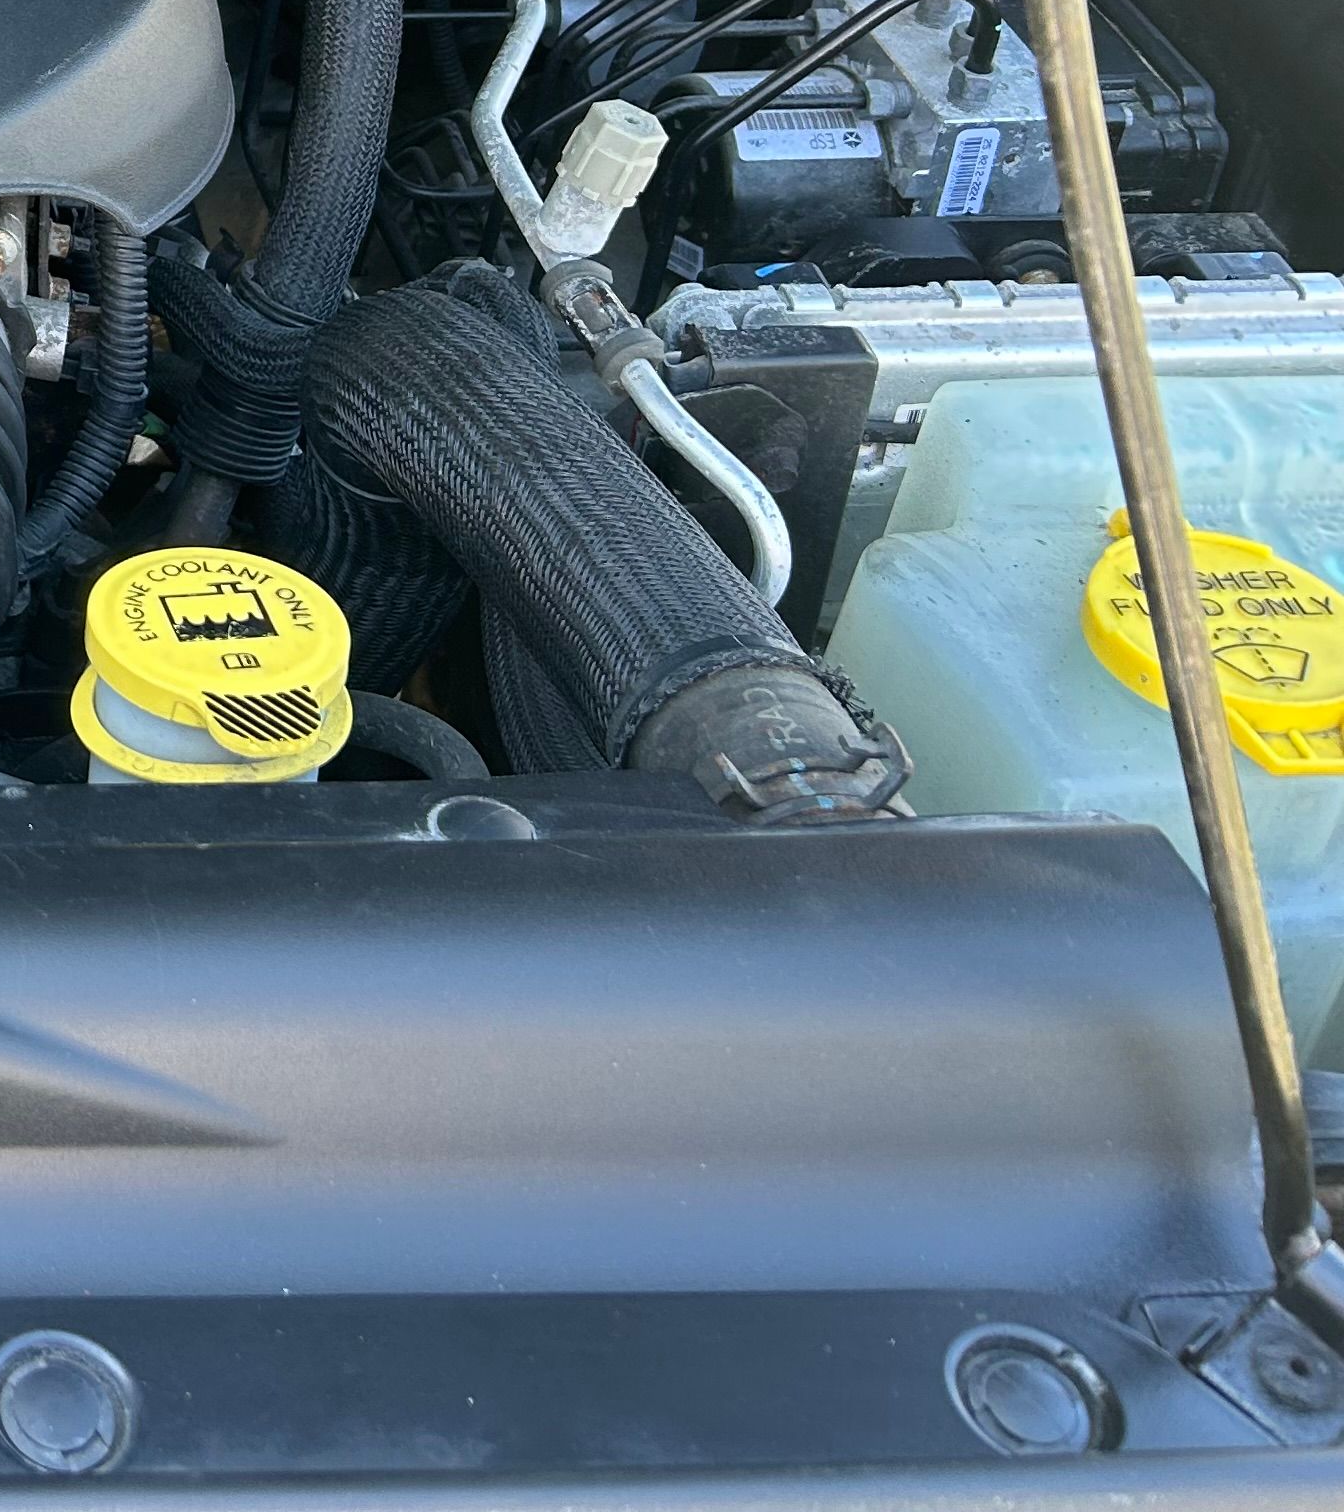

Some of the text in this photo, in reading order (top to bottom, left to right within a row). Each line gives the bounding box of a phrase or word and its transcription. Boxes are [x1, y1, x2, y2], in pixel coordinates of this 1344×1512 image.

[810, 132, 837, 149] ESP
[1122, 570, 1296, 591] WSHER
[124, 561, 314, 642] ENGINE COOLANT ONLY
[1236, 596, 1334, 616] ONLY
